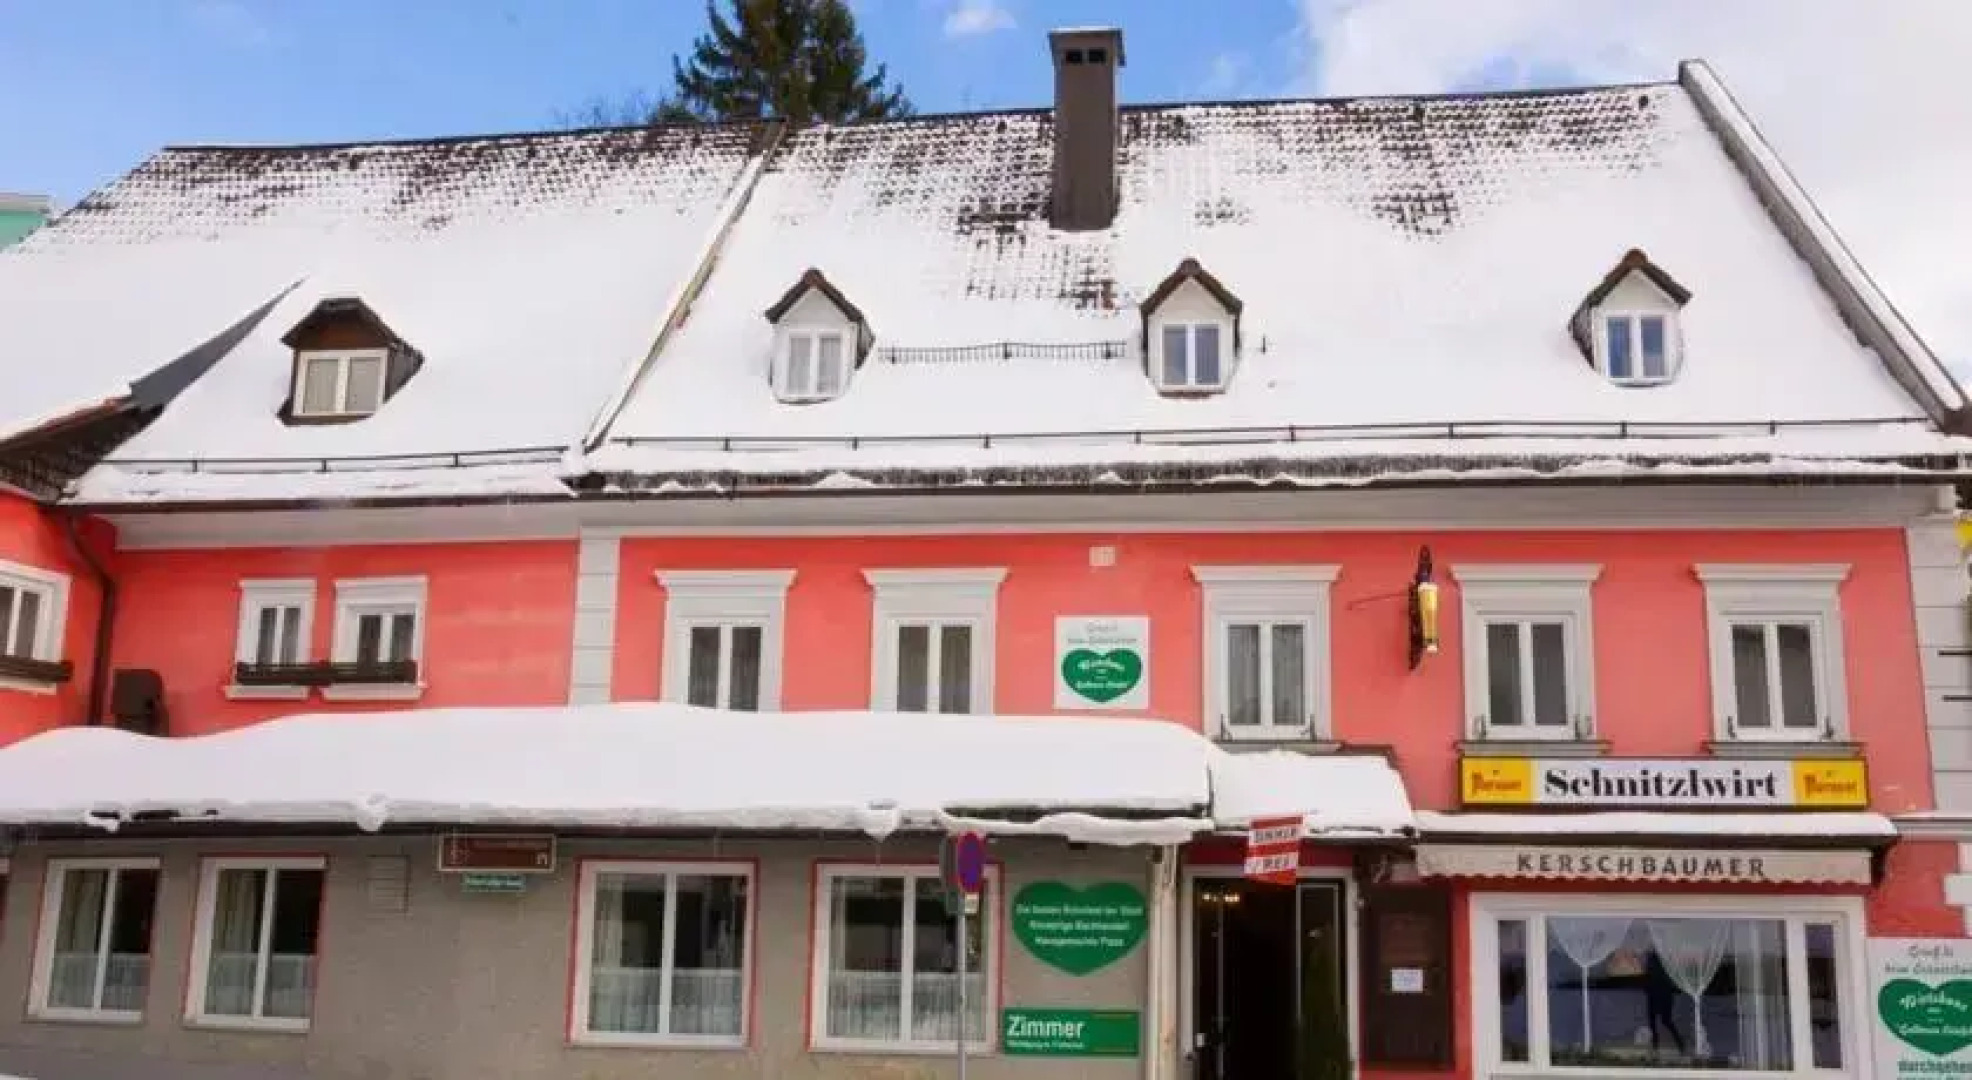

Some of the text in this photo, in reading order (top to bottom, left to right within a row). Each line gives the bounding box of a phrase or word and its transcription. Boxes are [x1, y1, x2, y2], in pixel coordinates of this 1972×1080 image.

[1544, 767, 1777, 798] Schnitzlwirt
[1516, 853, 1765, 877] KERSCHBAUMER
[1007, 1014, 1085, 1038] Zimmer
